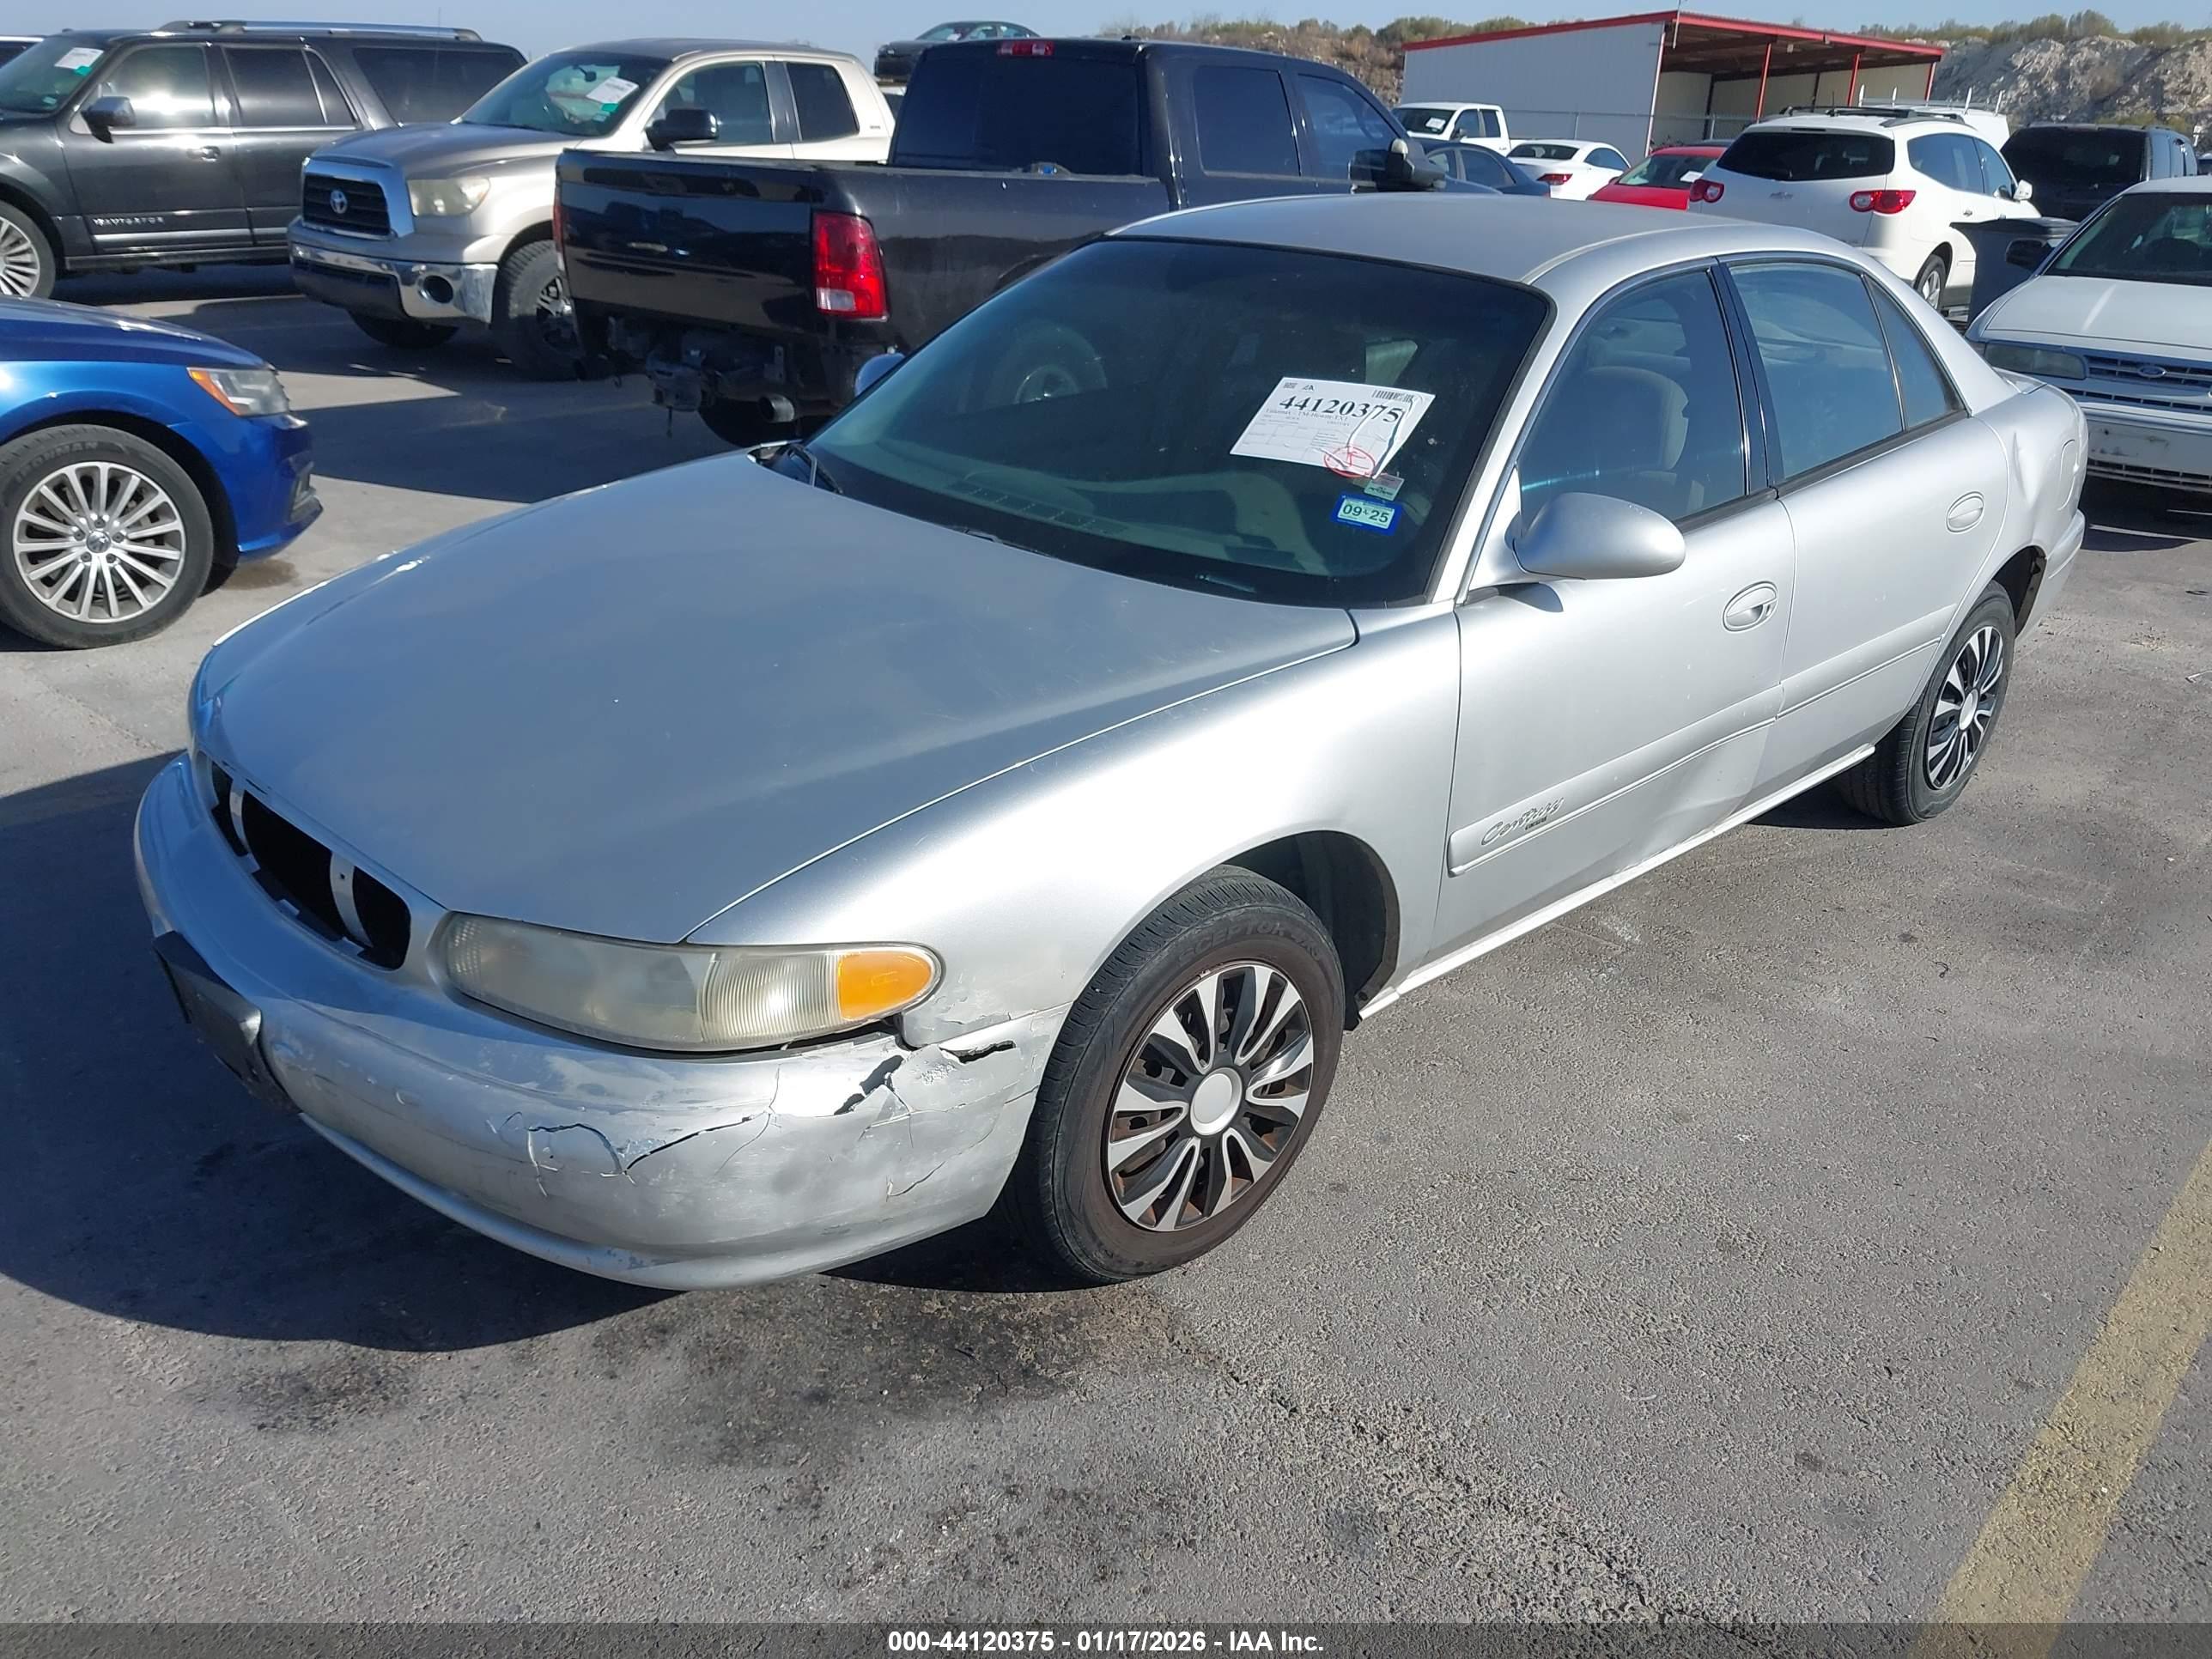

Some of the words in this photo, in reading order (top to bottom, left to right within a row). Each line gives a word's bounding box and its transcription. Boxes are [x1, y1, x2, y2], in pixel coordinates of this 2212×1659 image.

[92, 216, 164, 226] NAVIGATOR
[1279, 395, 1402, 422] 44120375
[1343, 504, 1362, 517] 09
[1369, 509, 1390, 523] 25
[1481, 797, 1564, 846] Century
